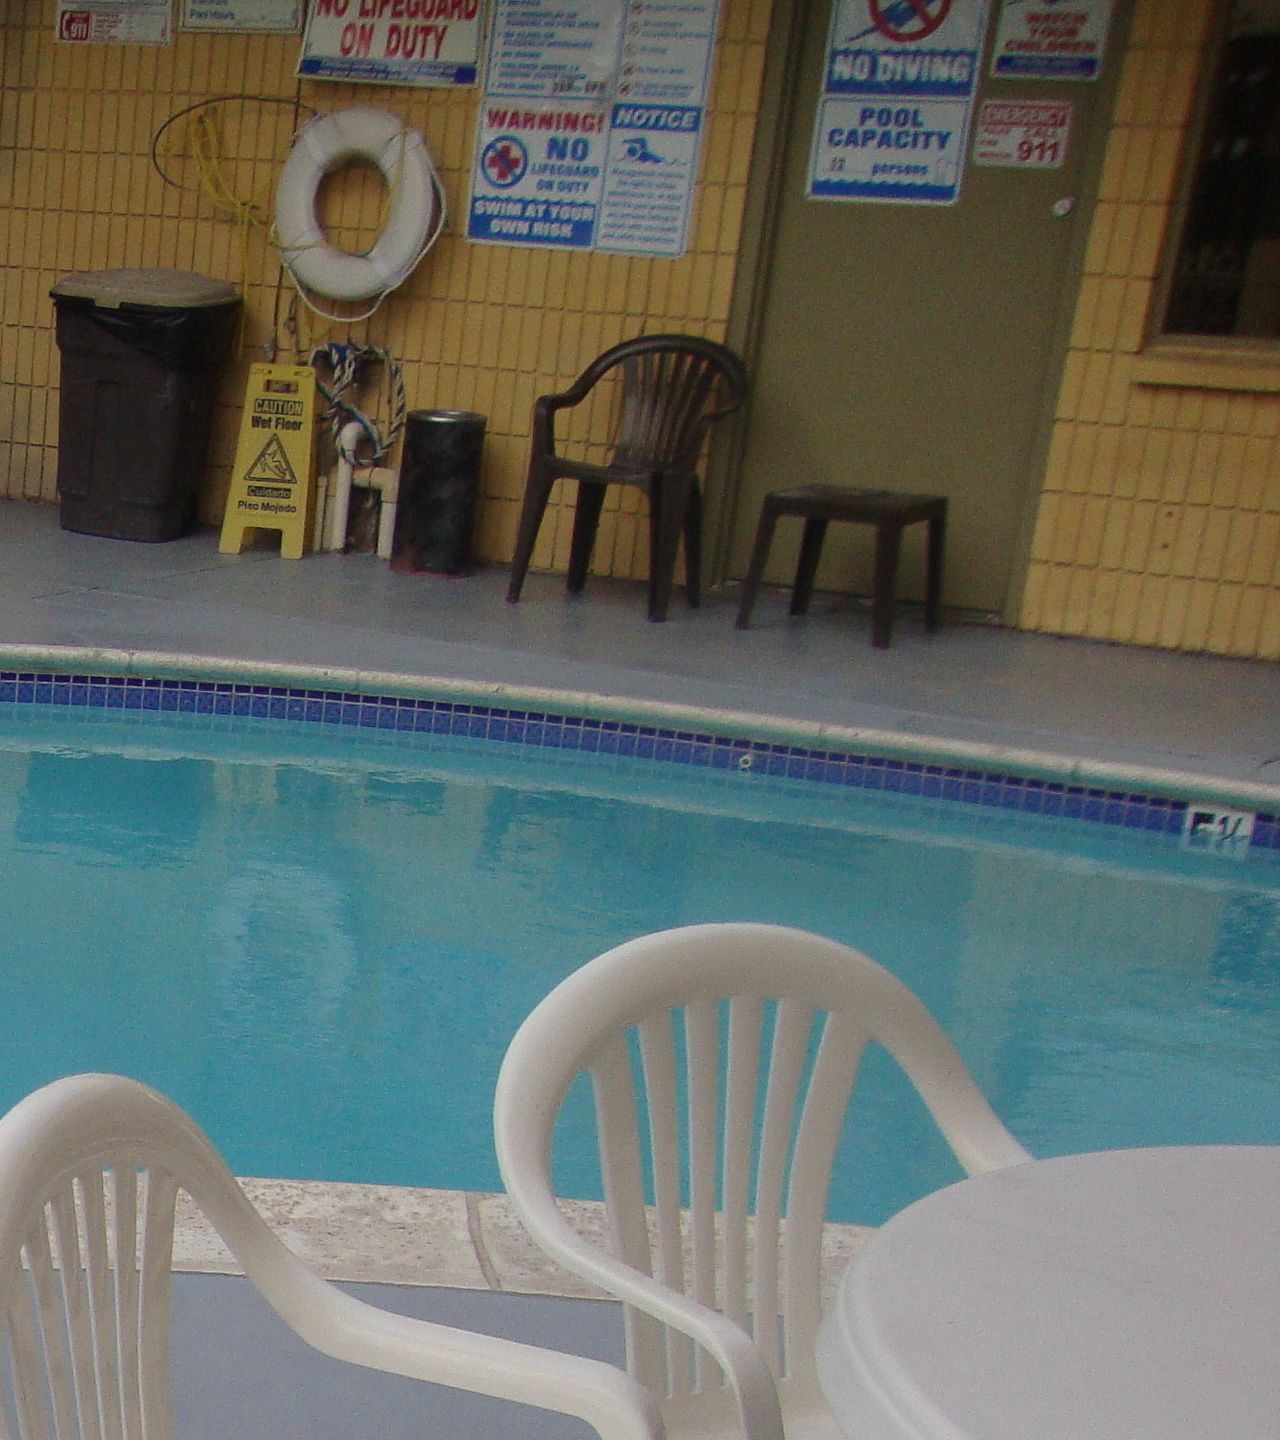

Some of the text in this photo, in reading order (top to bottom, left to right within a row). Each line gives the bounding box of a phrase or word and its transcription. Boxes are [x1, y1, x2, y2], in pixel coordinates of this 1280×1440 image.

[340, 22, 448, 59] ON DUTY
[833, 52, 974, 83] NO DIVING
[486, 109, 605, 134] WARNING!
[615, 107, 699, 129] NOTICE
[859, 107, 924, 127] POOL
[546, 136, 589, 161] NO
[828, 128, 953, 150] CAPACITY
[1017, 141, 1057, 162] 911
[474, 200, 522, 218] SWIM
[255, 400, 303, 415] CAUTION
[251, 415, 304, 431] Wet Floor
[237, 500, 297, 514] Piso Mojado
